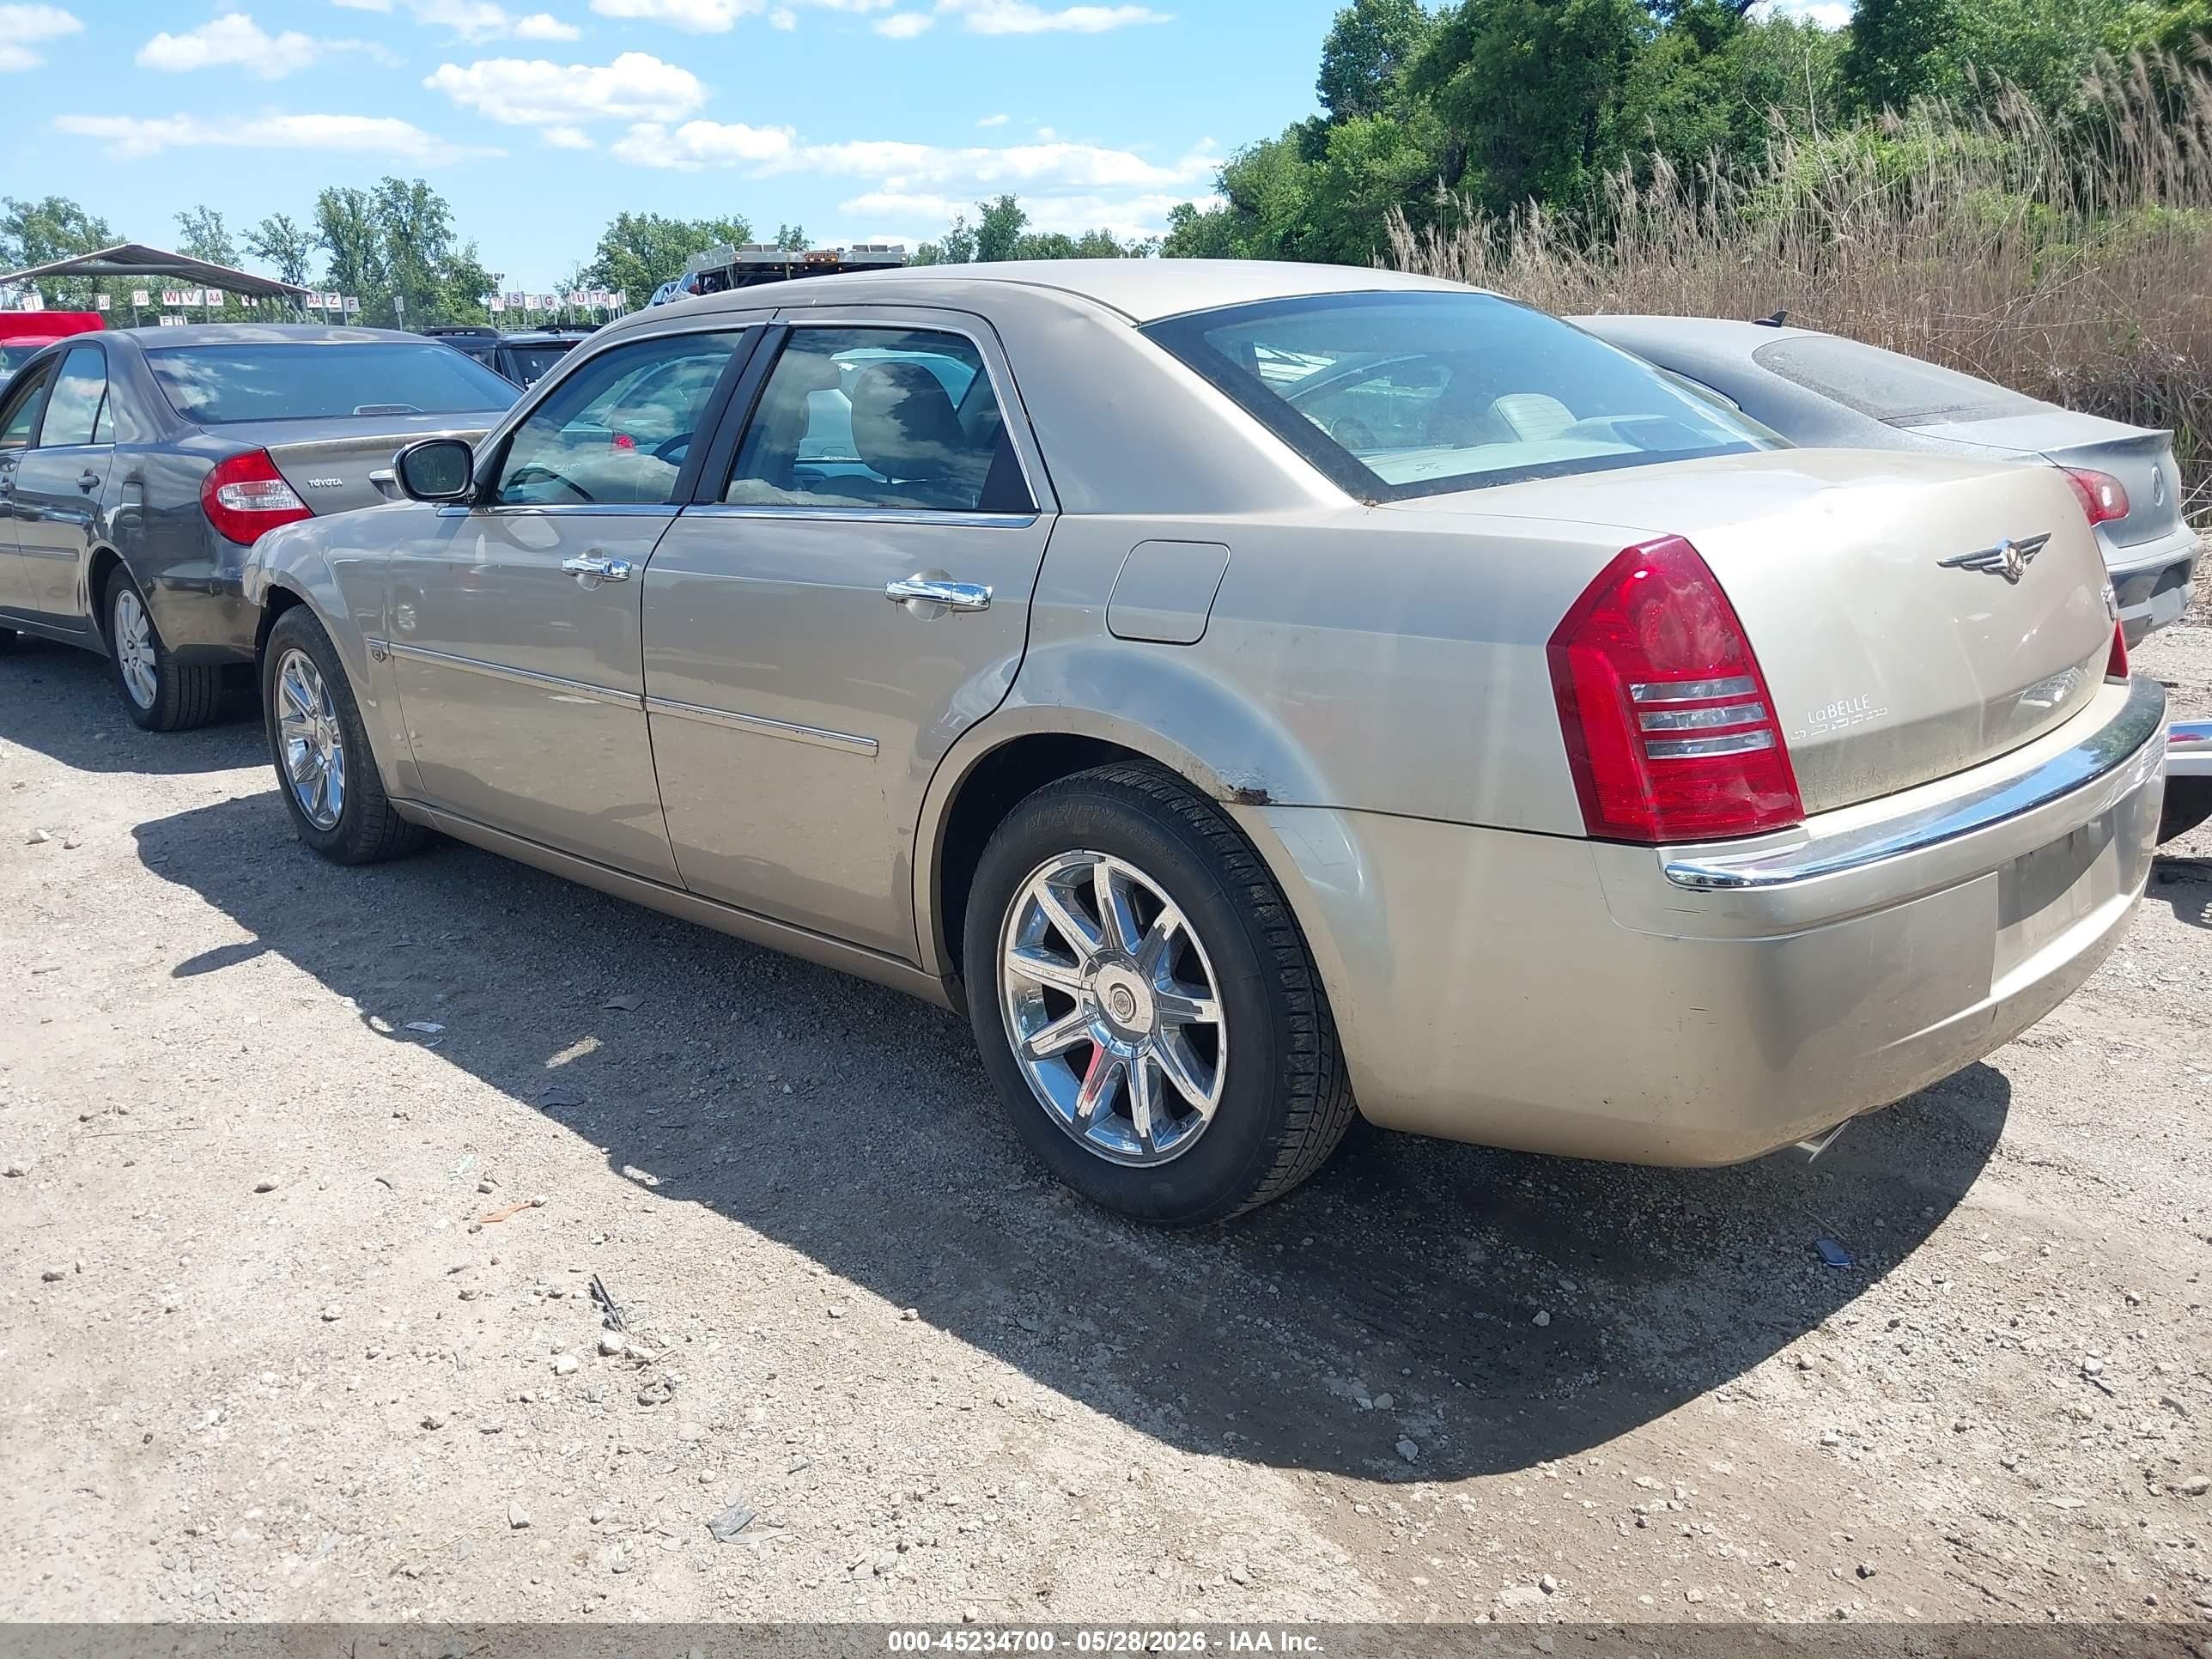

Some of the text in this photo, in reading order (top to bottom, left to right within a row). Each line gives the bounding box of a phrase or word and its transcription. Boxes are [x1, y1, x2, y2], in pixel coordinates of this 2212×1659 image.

[100, 296, 109, 307] 20
[136, 292, 147, 303] 20
[164, 291, 179, 303] W
[185, 291, 195, 302] V
[209, 292, 222, 303] AA
[309, 295, 320, 304] AA
[329, 295, 337, 305] Z
[513, 295, 520, 304] S
[544, 295, 553, 306] G
[577, 293, 585, 303] U
[593, 292, 601, 301] T
[349, 300, 355, 309] F
[493, 299, 503, 308] 70
[307, 477, 343, 489] TOYOTA
[1808, 693, 1871, 724] LaBELLE
